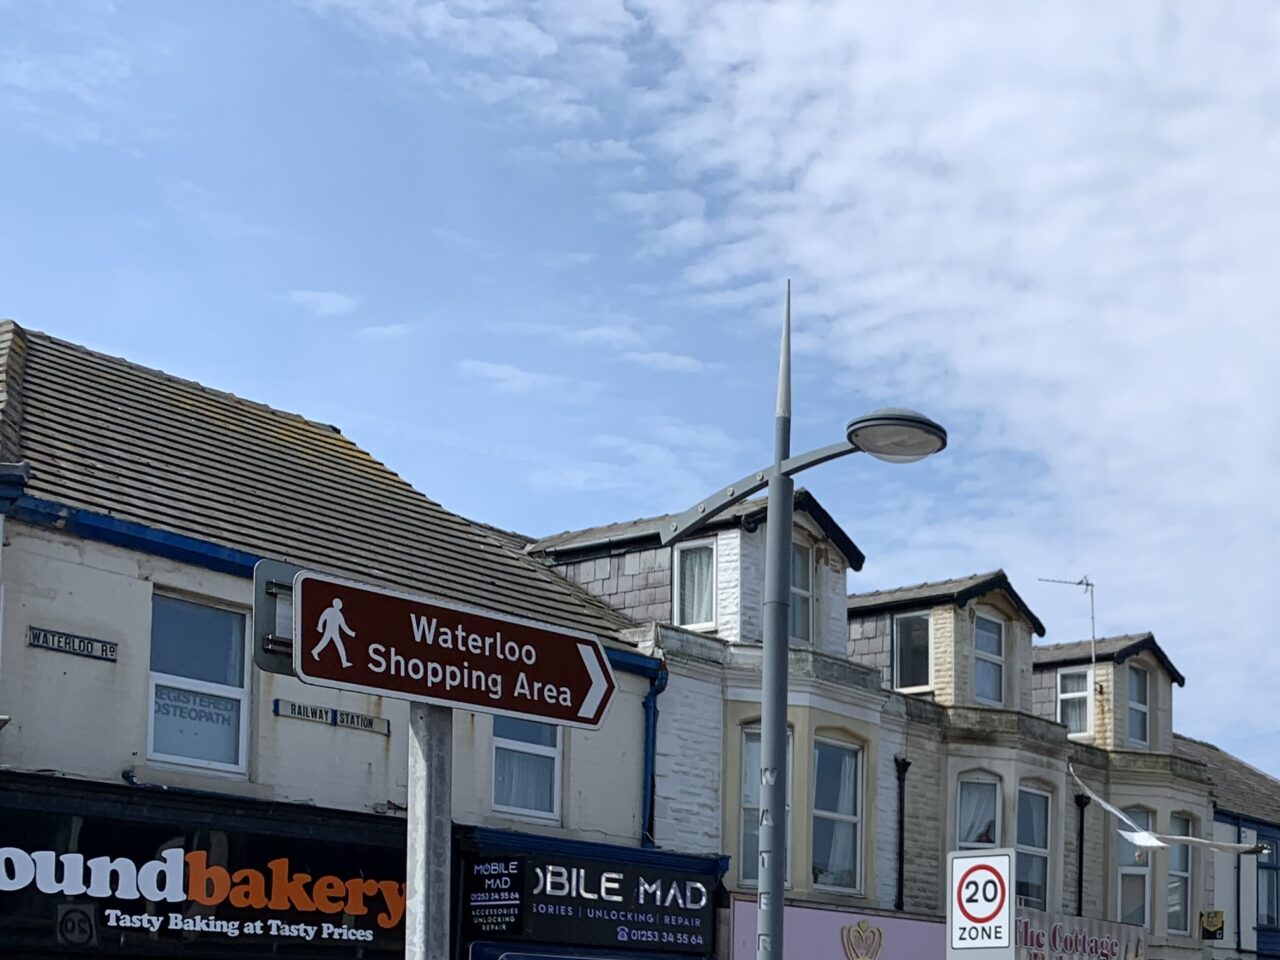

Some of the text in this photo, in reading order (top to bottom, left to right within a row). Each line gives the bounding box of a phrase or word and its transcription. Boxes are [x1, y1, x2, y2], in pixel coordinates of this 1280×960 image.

[32, 630, 94, 654] WATERLOO
[410, 613, 537, 665] Waterloo
[368, 643, 572, 707] Shopping Area
[290, 703, 329, 721] RAILWAY
[339, 712, 374, 729] STATION
[474, 861, 518, 875] MOBILE
[485, 877, 511, 889] MAD
[964, 879, 999, 904] 20
[638, 876, 708, 909] MAD
[105, 909, 374, 942] Tasty Baking at Tasty Prices
[587, 909, 653, 924] UNLOCKING
[663, 915, 701, 927] REPAIR
[630, 929, 703, 945] 01253 34 55 64
[959, 926, 1003, 941] ZONE
